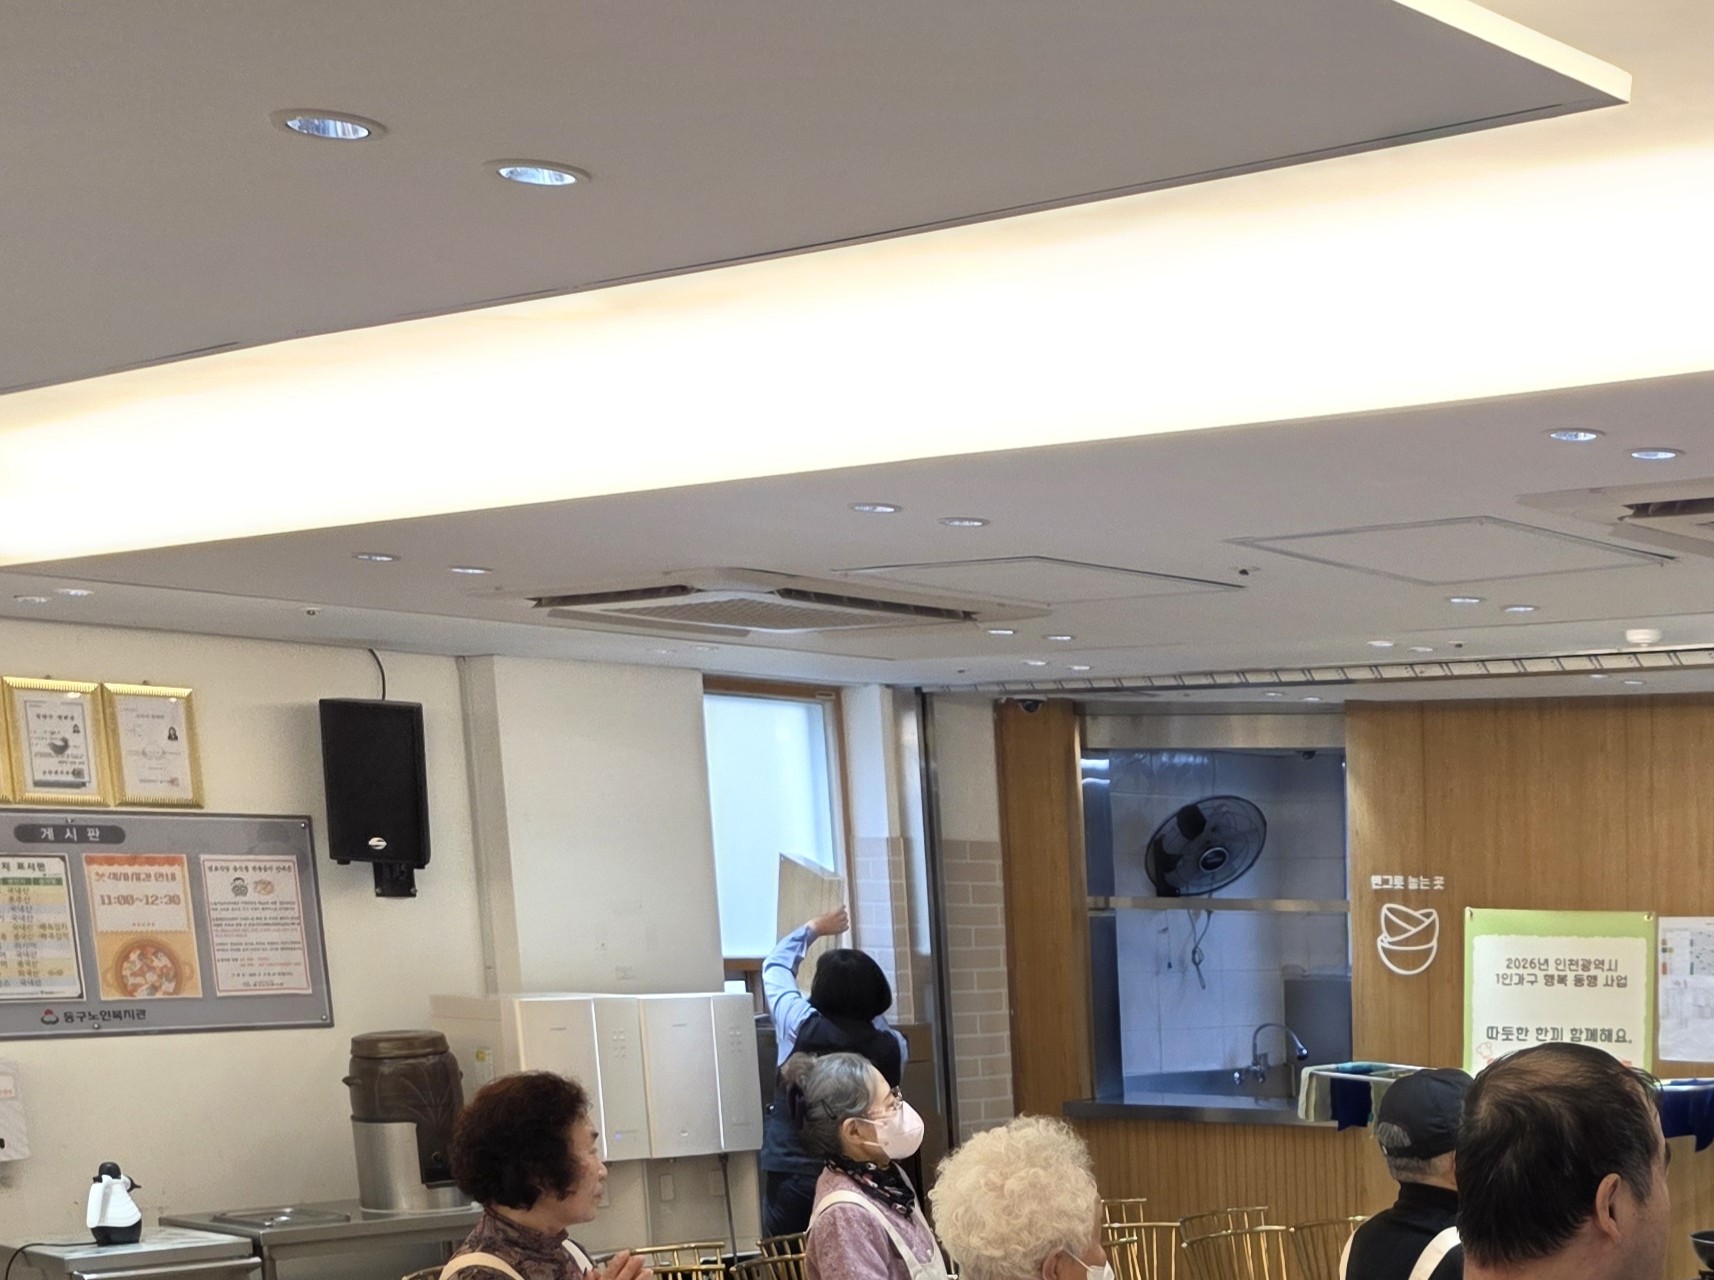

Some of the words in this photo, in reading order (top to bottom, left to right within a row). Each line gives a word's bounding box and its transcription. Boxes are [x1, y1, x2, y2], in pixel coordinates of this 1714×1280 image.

[1433, 876, 1445, 889] 곳
[1506, 958, 1549, 971] 2026년
[1555, 958, 1618, 972] 인천광역시
[1496, 973, 1538, 986] 1인가구
[1543, 974, 1568, 987] 행복
[1573, 974, 1598, 987] 동행
[1602, 975, 1628, 988] 사업
[63, 1009, 147, 1024] 동구노인복지관
[1486, 1026, 1530, 1042] 따듯한
[1535, 1026, 1564, 1042] 한끼
